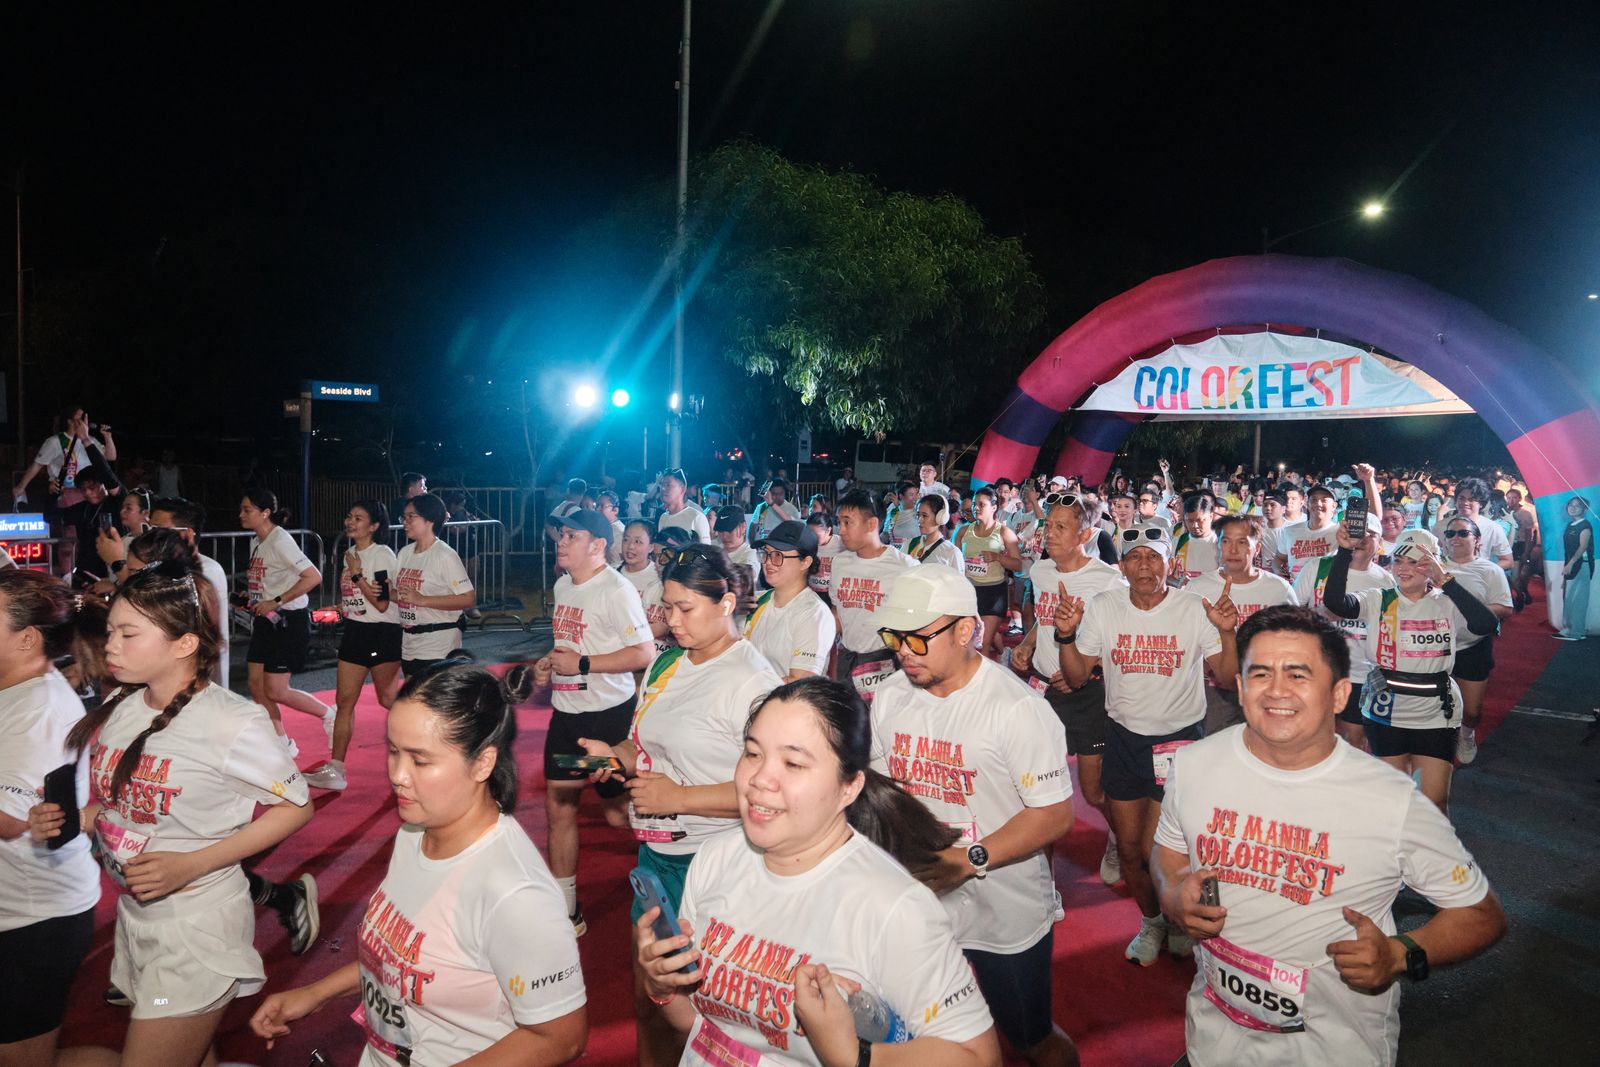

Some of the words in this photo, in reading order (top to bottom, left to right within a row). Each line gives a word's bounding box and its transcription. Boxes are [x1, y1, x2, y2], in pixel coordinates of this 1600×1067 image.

[320, 386, 352, 395] Seaside
[353, 388, 371, 396] Blvd
[1133, 356, 1361, 410] COLORFEST
[18, 521, 45, 531] TIME
[1117, 633, 1132, 649] JCI
[1135, 634, 1177, 650] MANILA
[1410, 633, 1451, 645] 10906
[1111, 648, 1186, 669] COLORFEST
[1121, 665, 1156, 675] CARNIVAL
[893, 732, 912, 757] JCI
[915, 736, 964, 768] MANILA
[889, 755, 977, 796] COLORFEST
[121, 837, 144, 854] 10K
[1206, 807, 1239, 838] JCI
[1241, 814, 1330, 860] MANILA
[1195, 833, 1345, 897] COLORFEST
[372, 900, 426, 965] MANILA
[701, 917, 735, 958] JCI
[1273, 967, 1301, 987] 10K
[1217, 966, 1299, 1018] 10859
